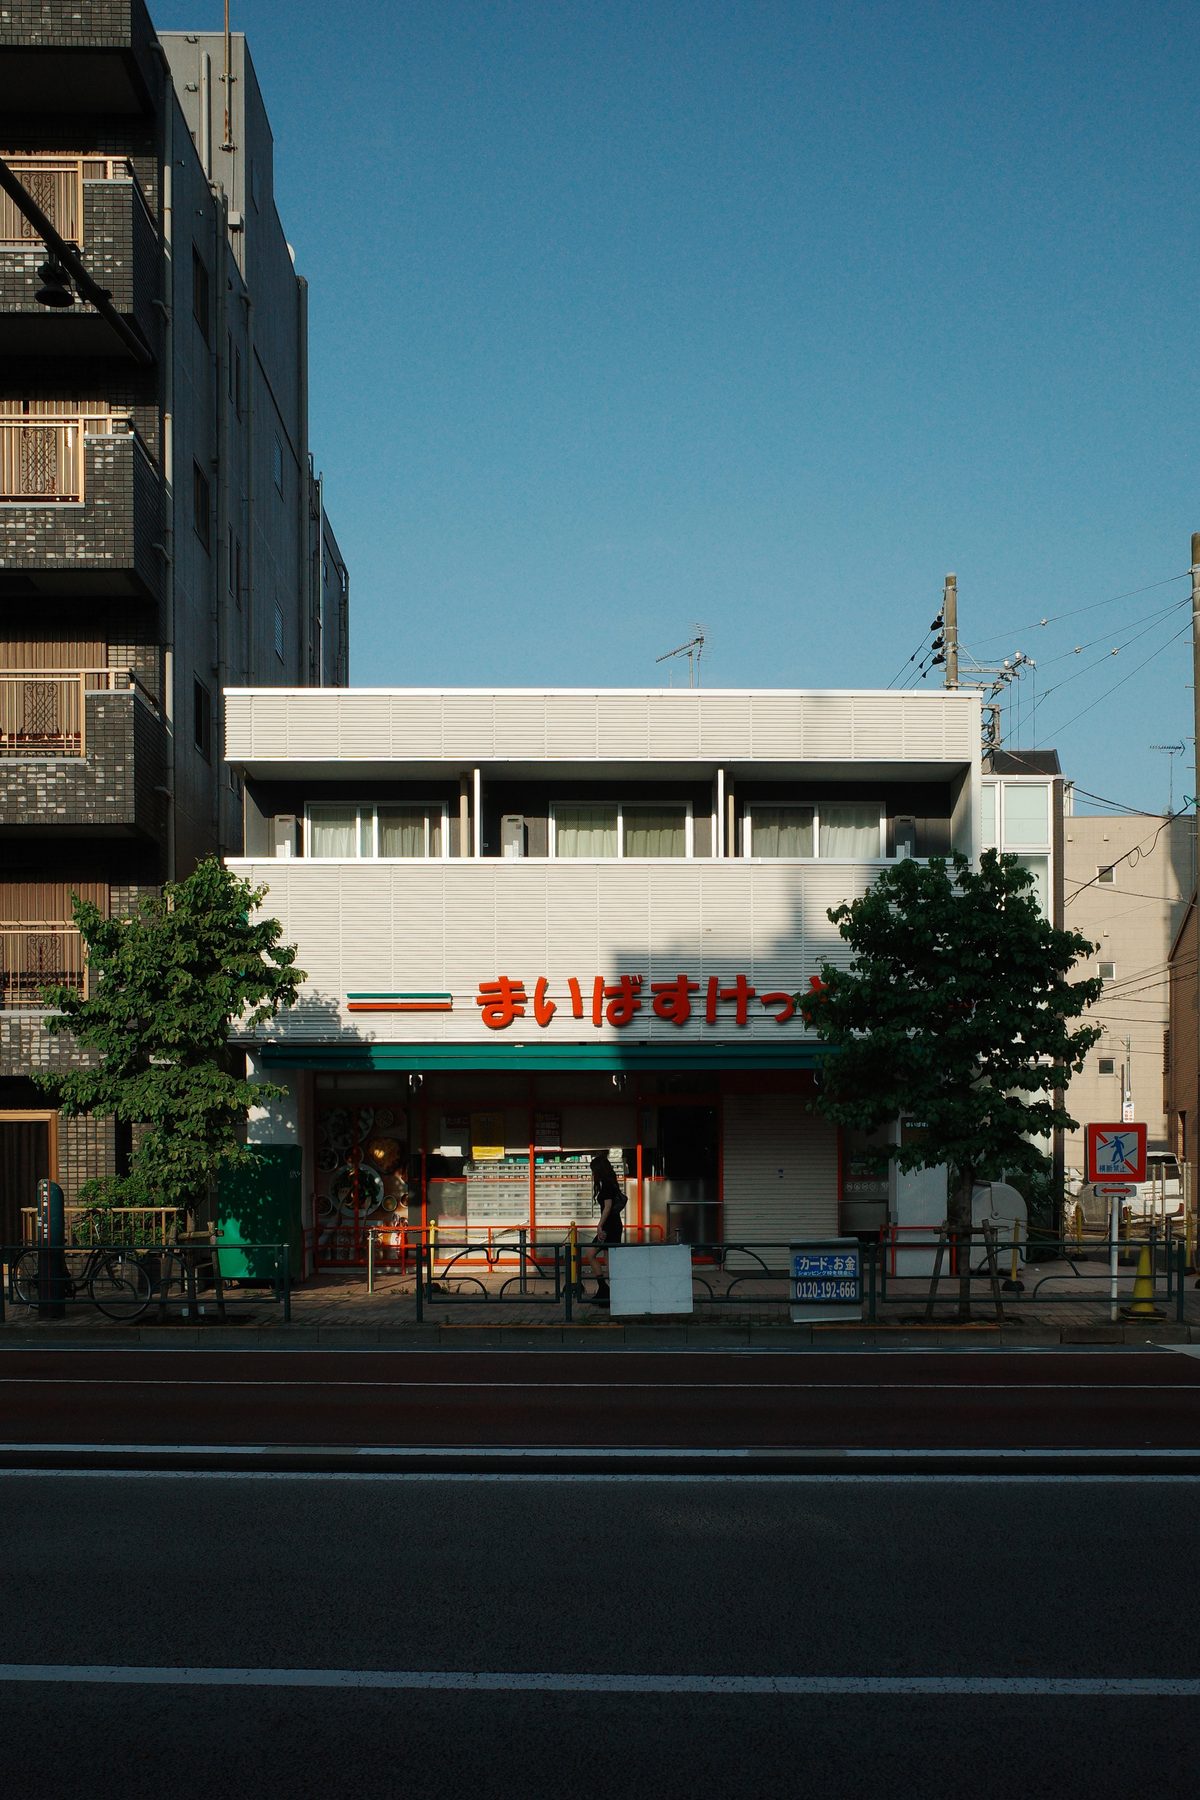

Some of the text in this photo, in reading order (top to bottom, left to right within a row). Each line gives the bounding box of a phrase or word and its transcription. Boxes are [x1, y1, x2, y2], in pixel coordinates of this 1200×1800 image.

[1099, 1164, 1126, 1173] 横断禁止
[800, 1256, 856, 1270] カードでお金
